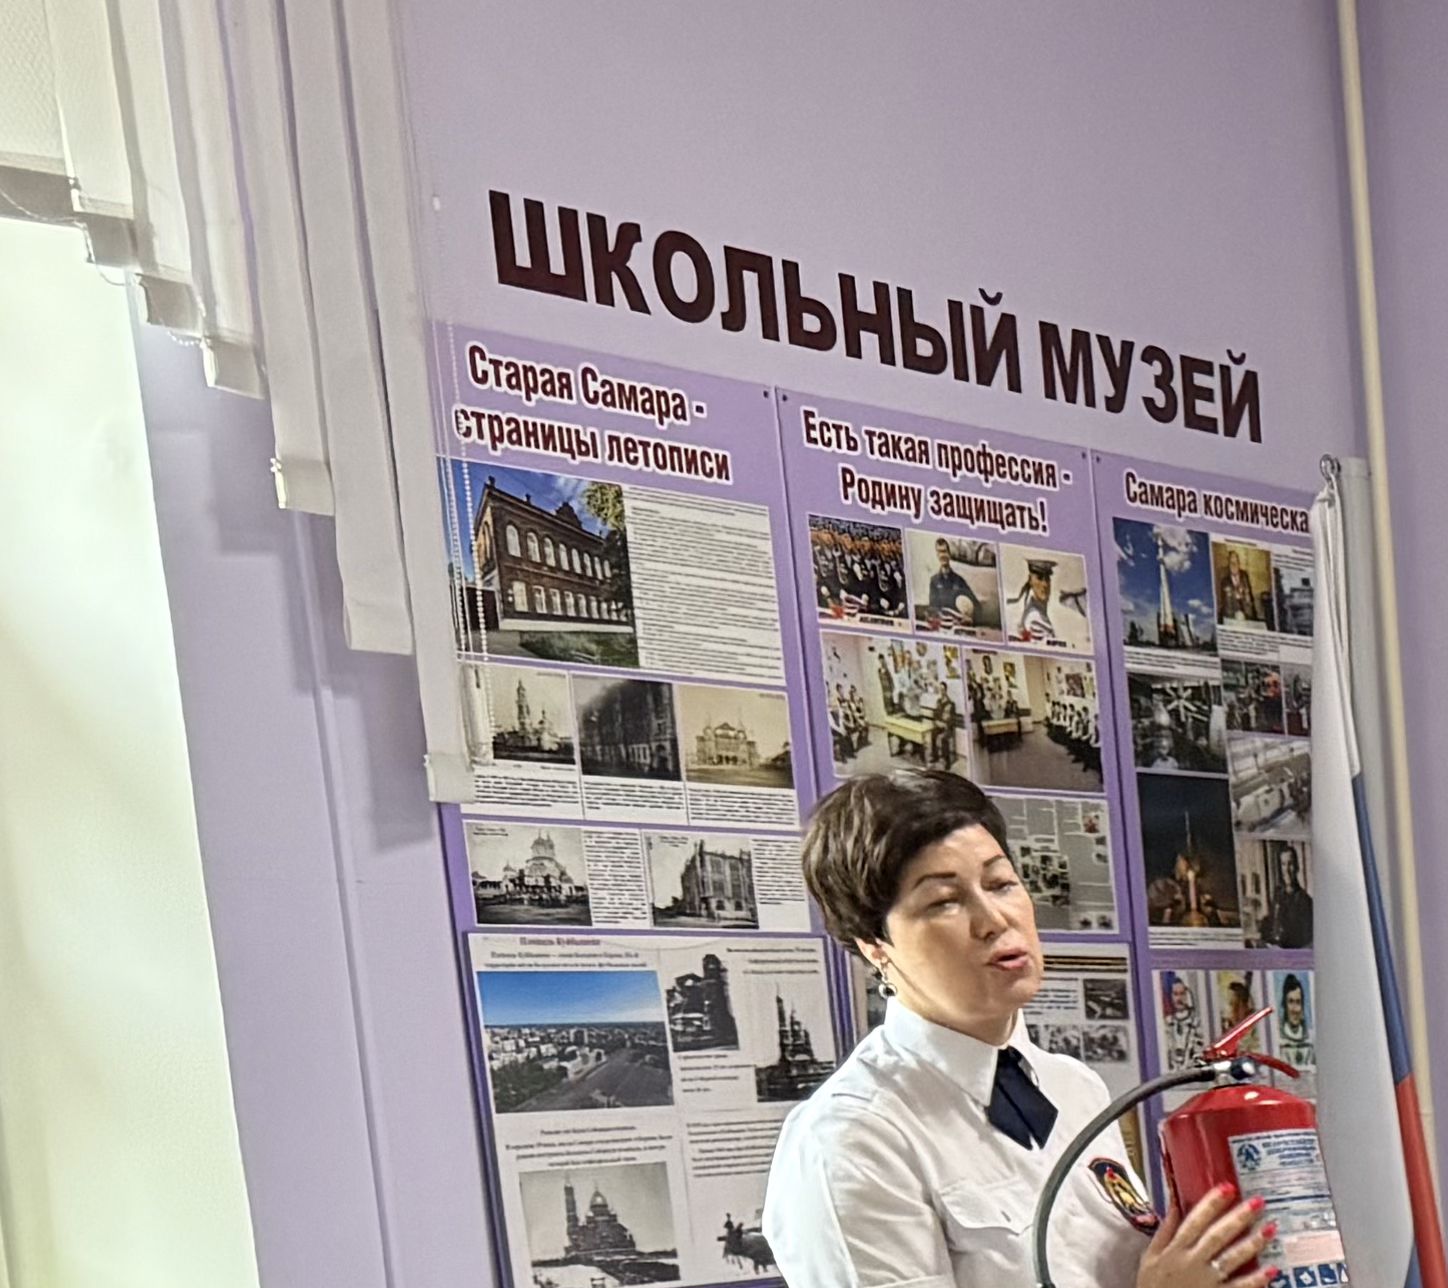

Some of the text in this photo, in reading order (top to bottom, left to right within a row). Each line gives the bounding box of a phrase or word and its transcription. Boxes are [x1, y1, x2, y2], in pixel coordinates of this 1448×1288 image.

[488, 189, 1263, 444] ШКОЛЬНЫЙ МУЗЕЙ
[467, 344, 574, 402] Старая
[580, 366, 688, 426] Самара
[454, 408, 731, 481] страницы летописи
[803, 409, 859, 452] Есть
[864, 428, 930, 466] такая
[936, 442, 1058, 489] профессия
[841, 466, 1048, 533] Родину защищать!
[1125, 471, 1310, 534] Самара космическа
